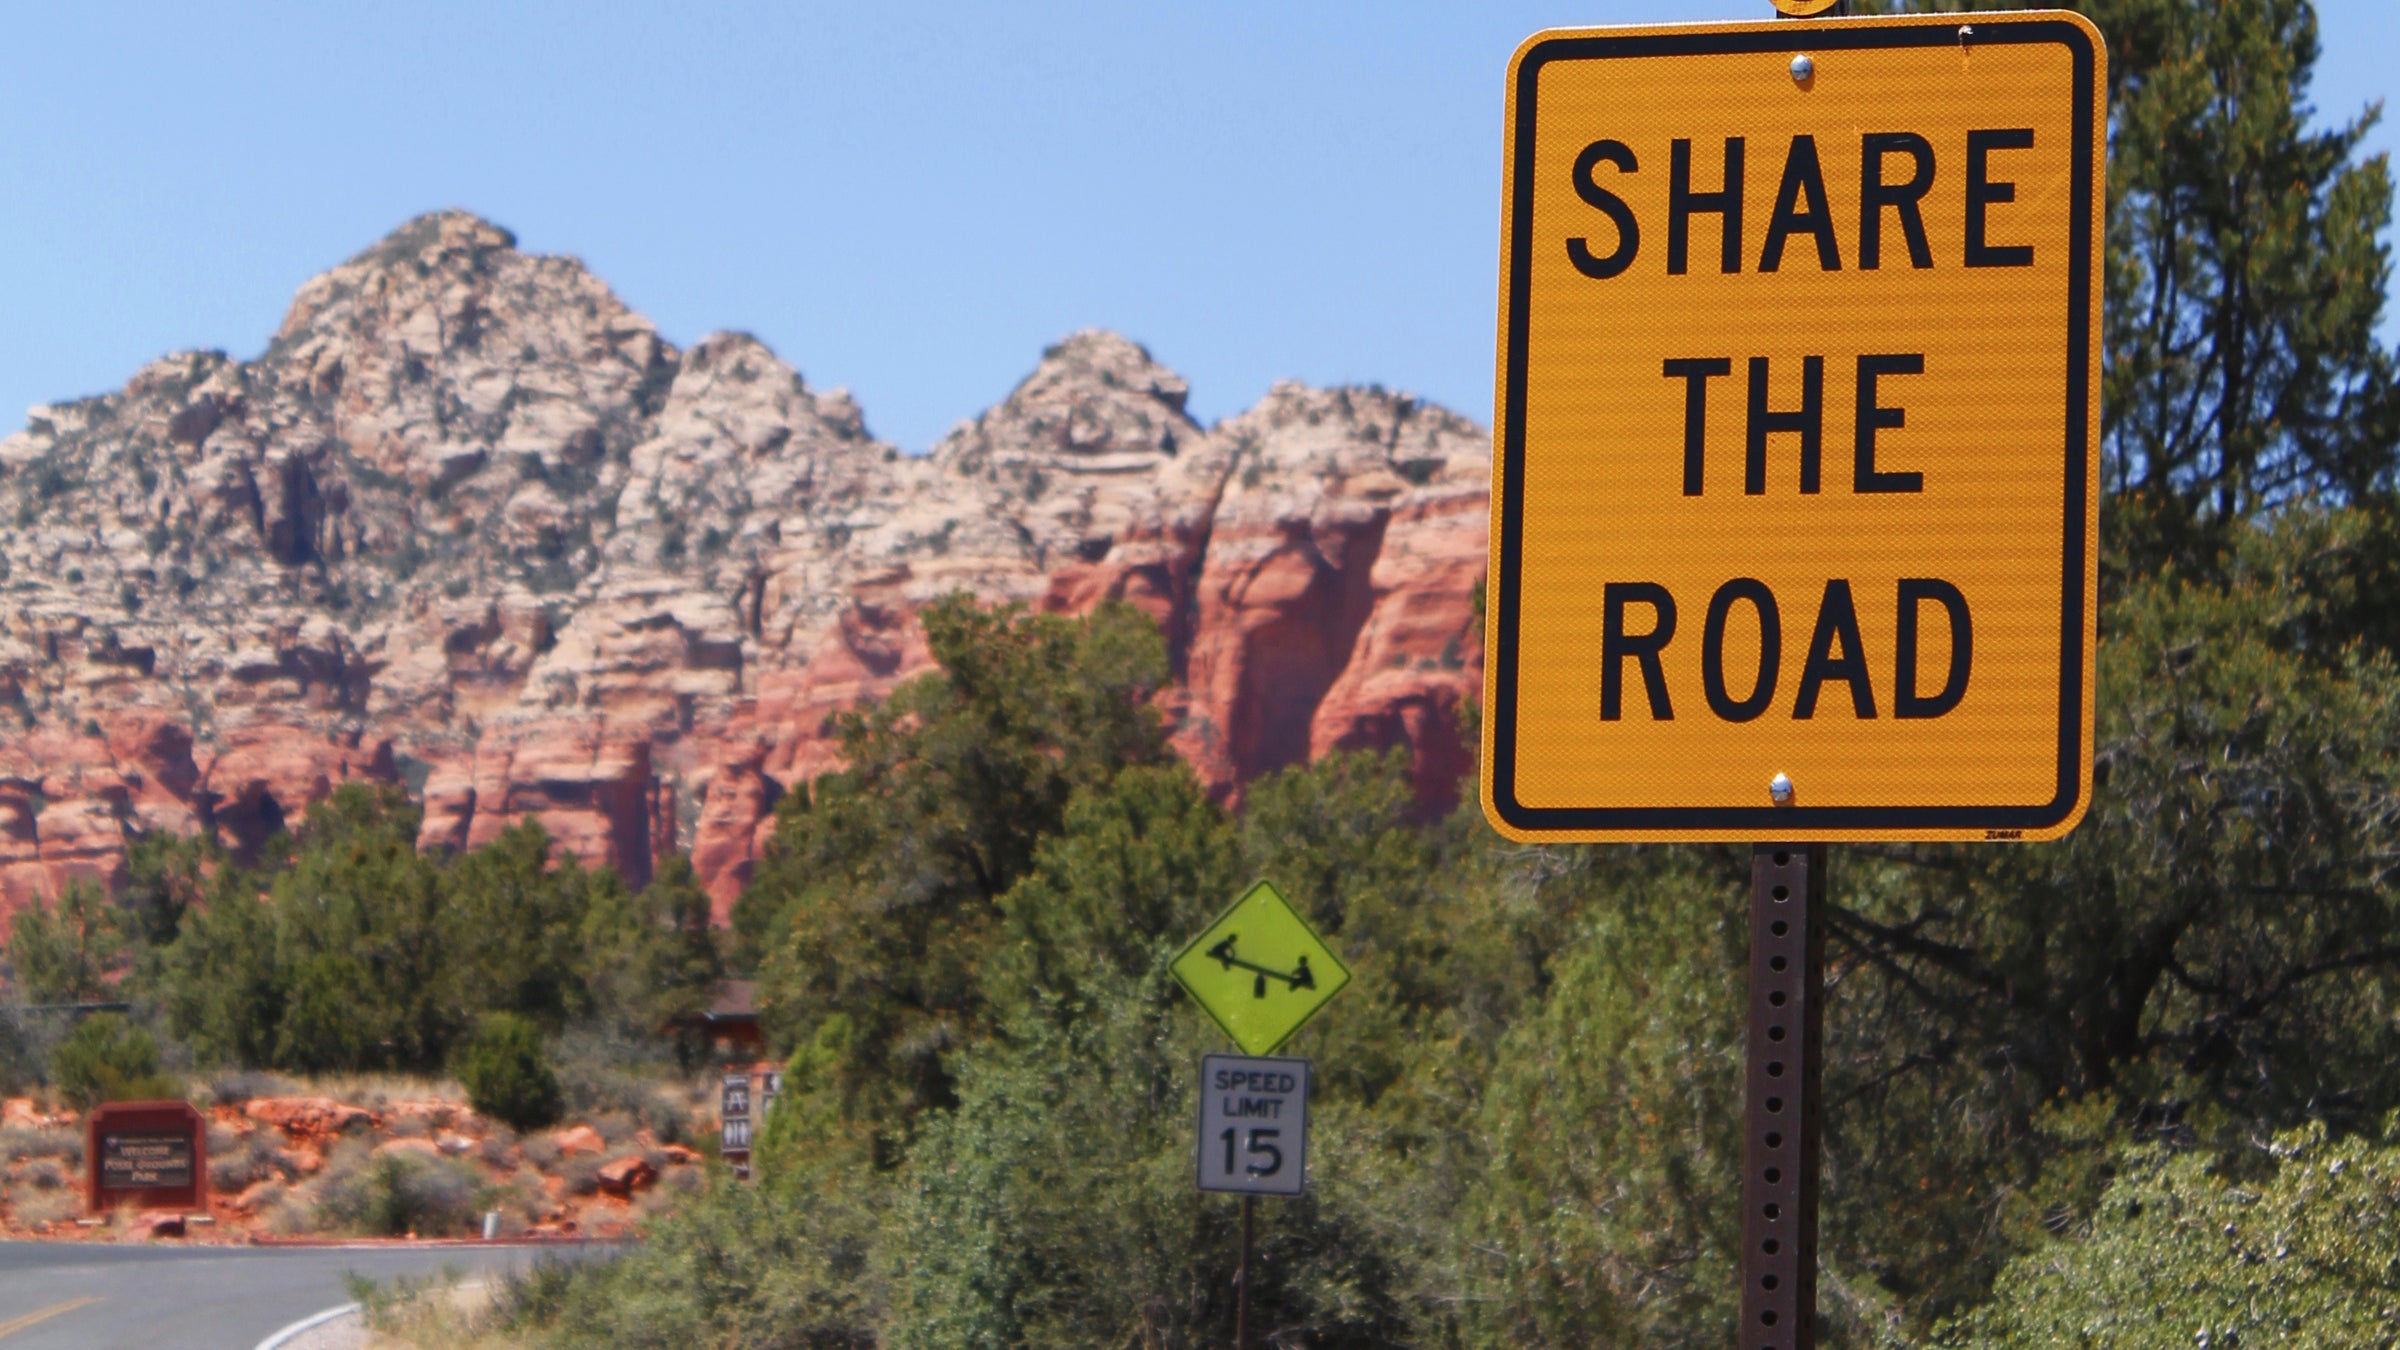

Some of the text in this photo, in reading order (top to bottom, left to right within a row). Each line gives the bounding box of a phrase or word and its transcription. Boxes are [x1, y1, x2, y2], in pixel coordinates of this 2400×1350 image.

[1565, 127, 2035, 280] SHARE
[1663, 354, 1925, 497] THE
[1599, 577, 1973, 724] ROAD
[1214, 1070, 1295, 1093] SPEED
[1223, 1096, 1284, 1119] LIMIT
[1220, 1126, 1282, 1177] 15
